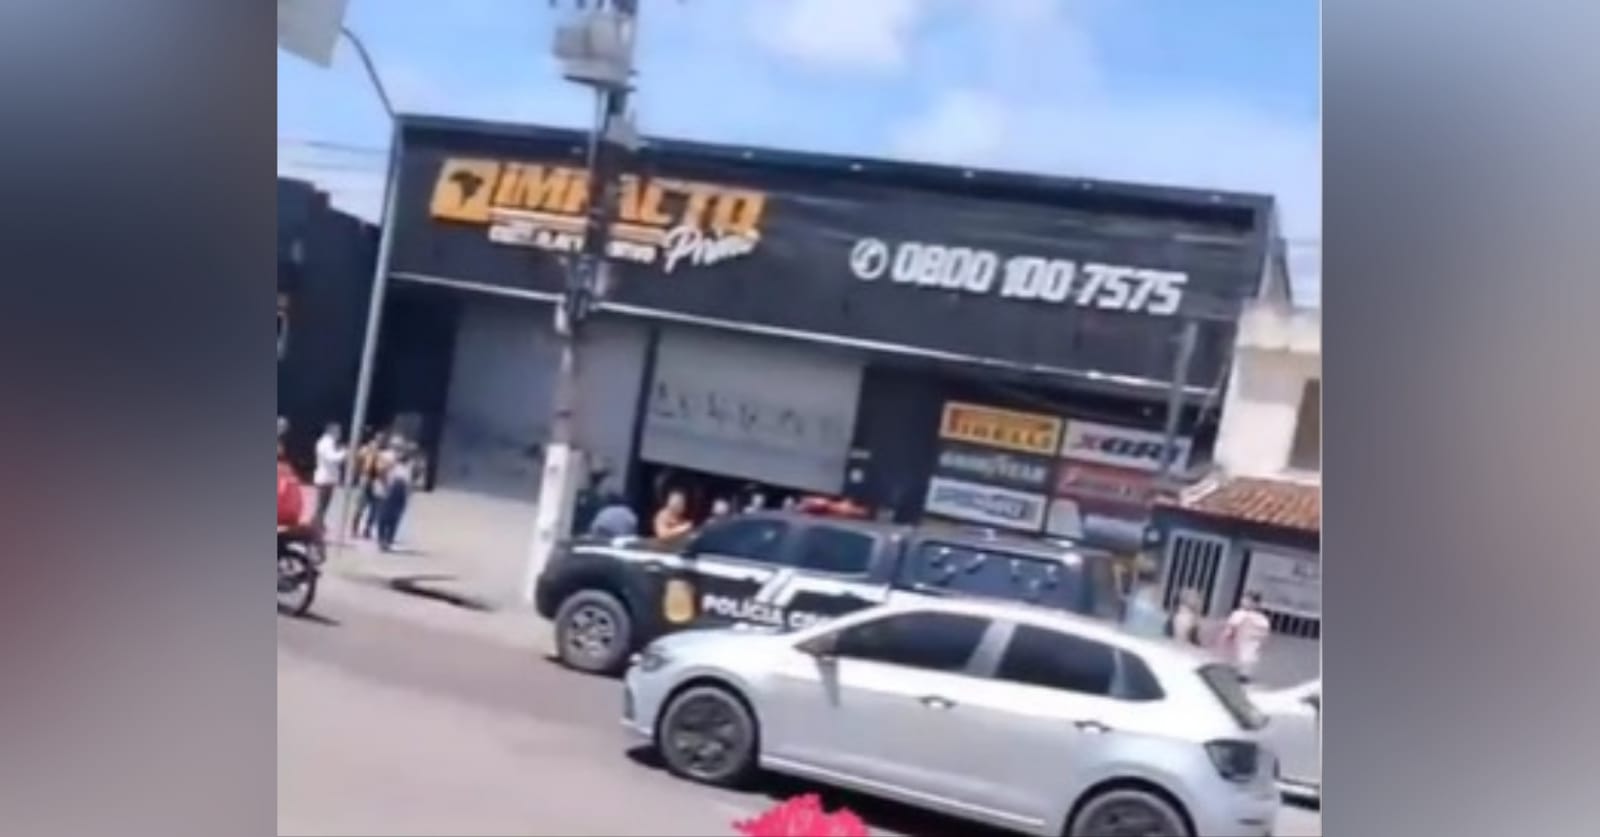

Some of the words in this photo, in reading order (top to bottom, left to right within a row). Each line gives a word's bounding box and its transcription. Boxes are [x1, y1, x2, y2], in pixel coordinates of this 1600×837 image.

[892, 242, 998, 293] 0800
[1001, 256, 1076, 303] 100
[1076, 264, 1189, 316] 7575
